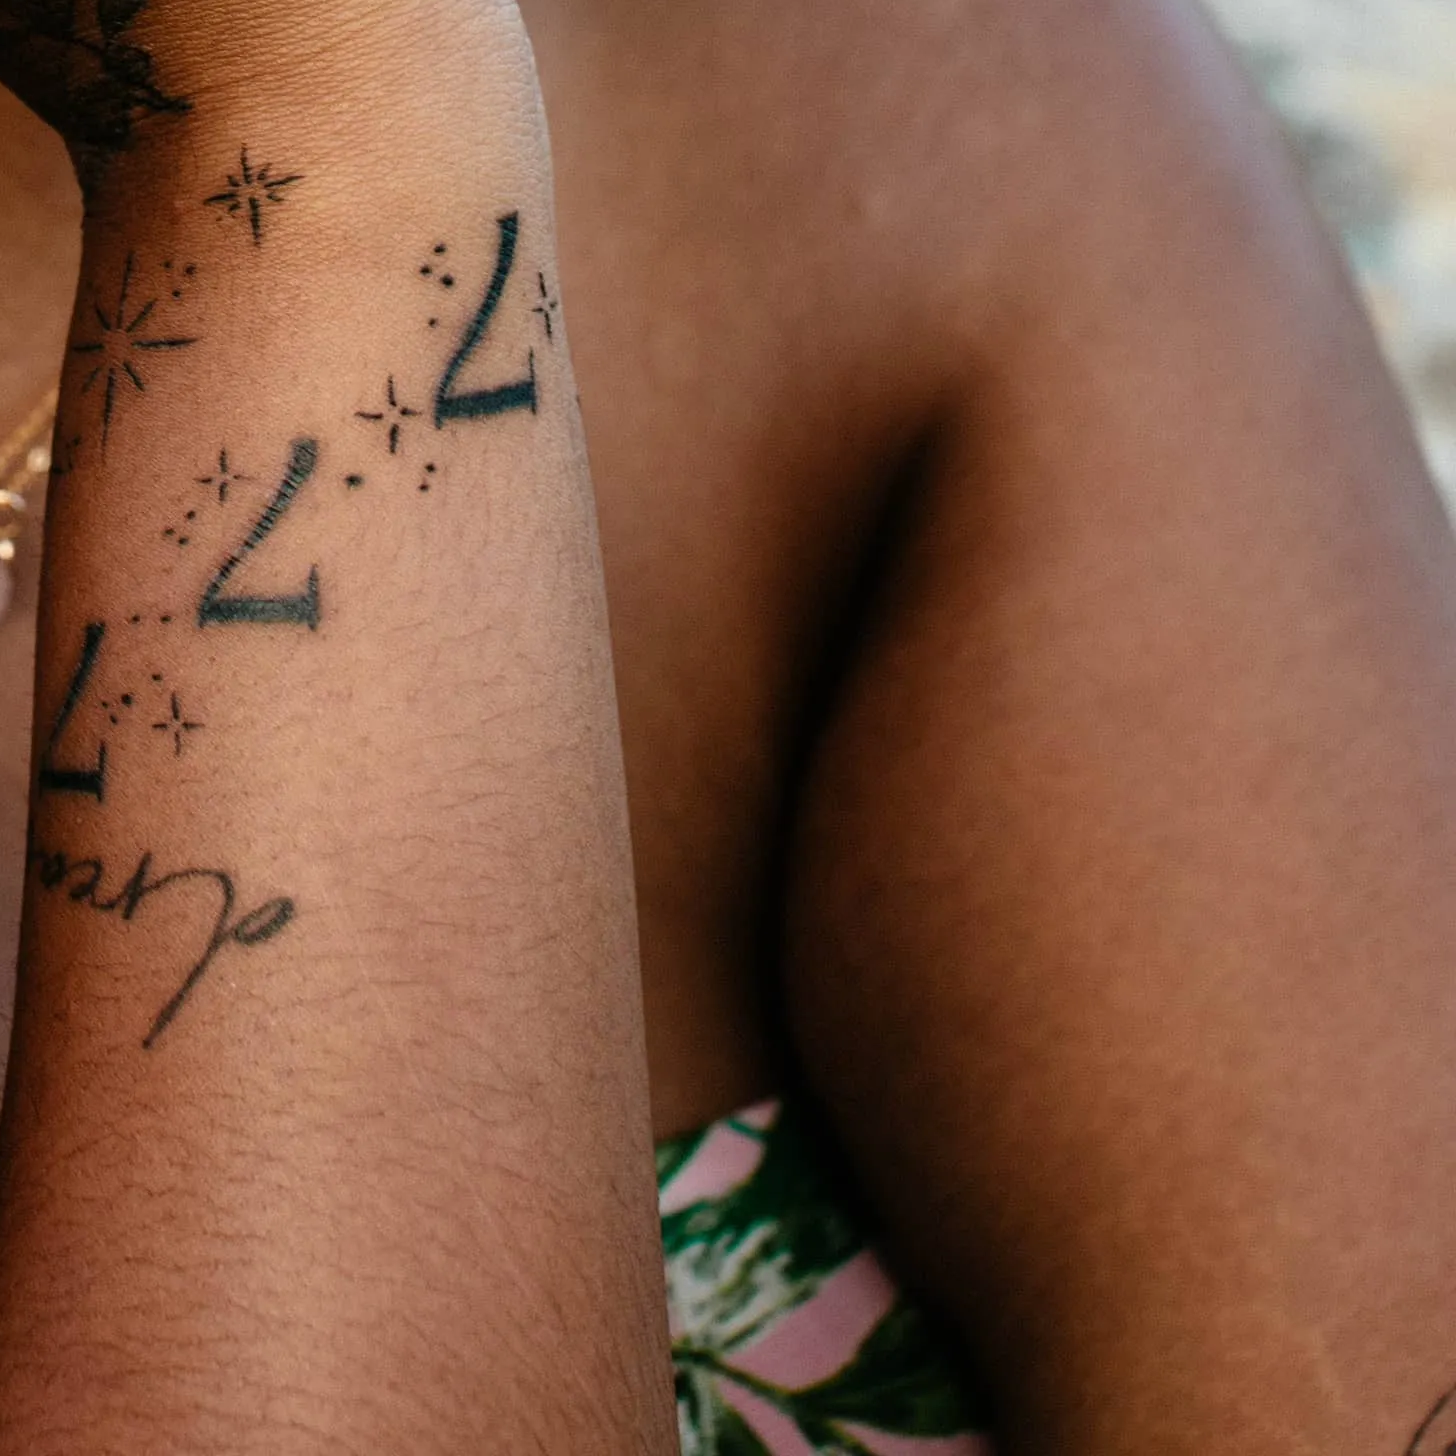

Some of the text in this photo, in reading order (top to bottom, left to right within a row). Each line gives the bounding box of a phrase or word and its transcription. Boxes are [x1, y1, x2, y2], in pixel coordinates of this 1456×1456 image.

[434, 210, 537, 430] 7
[198, 437, 320, 630] 7
[30, 848, 296, 1050] drea
